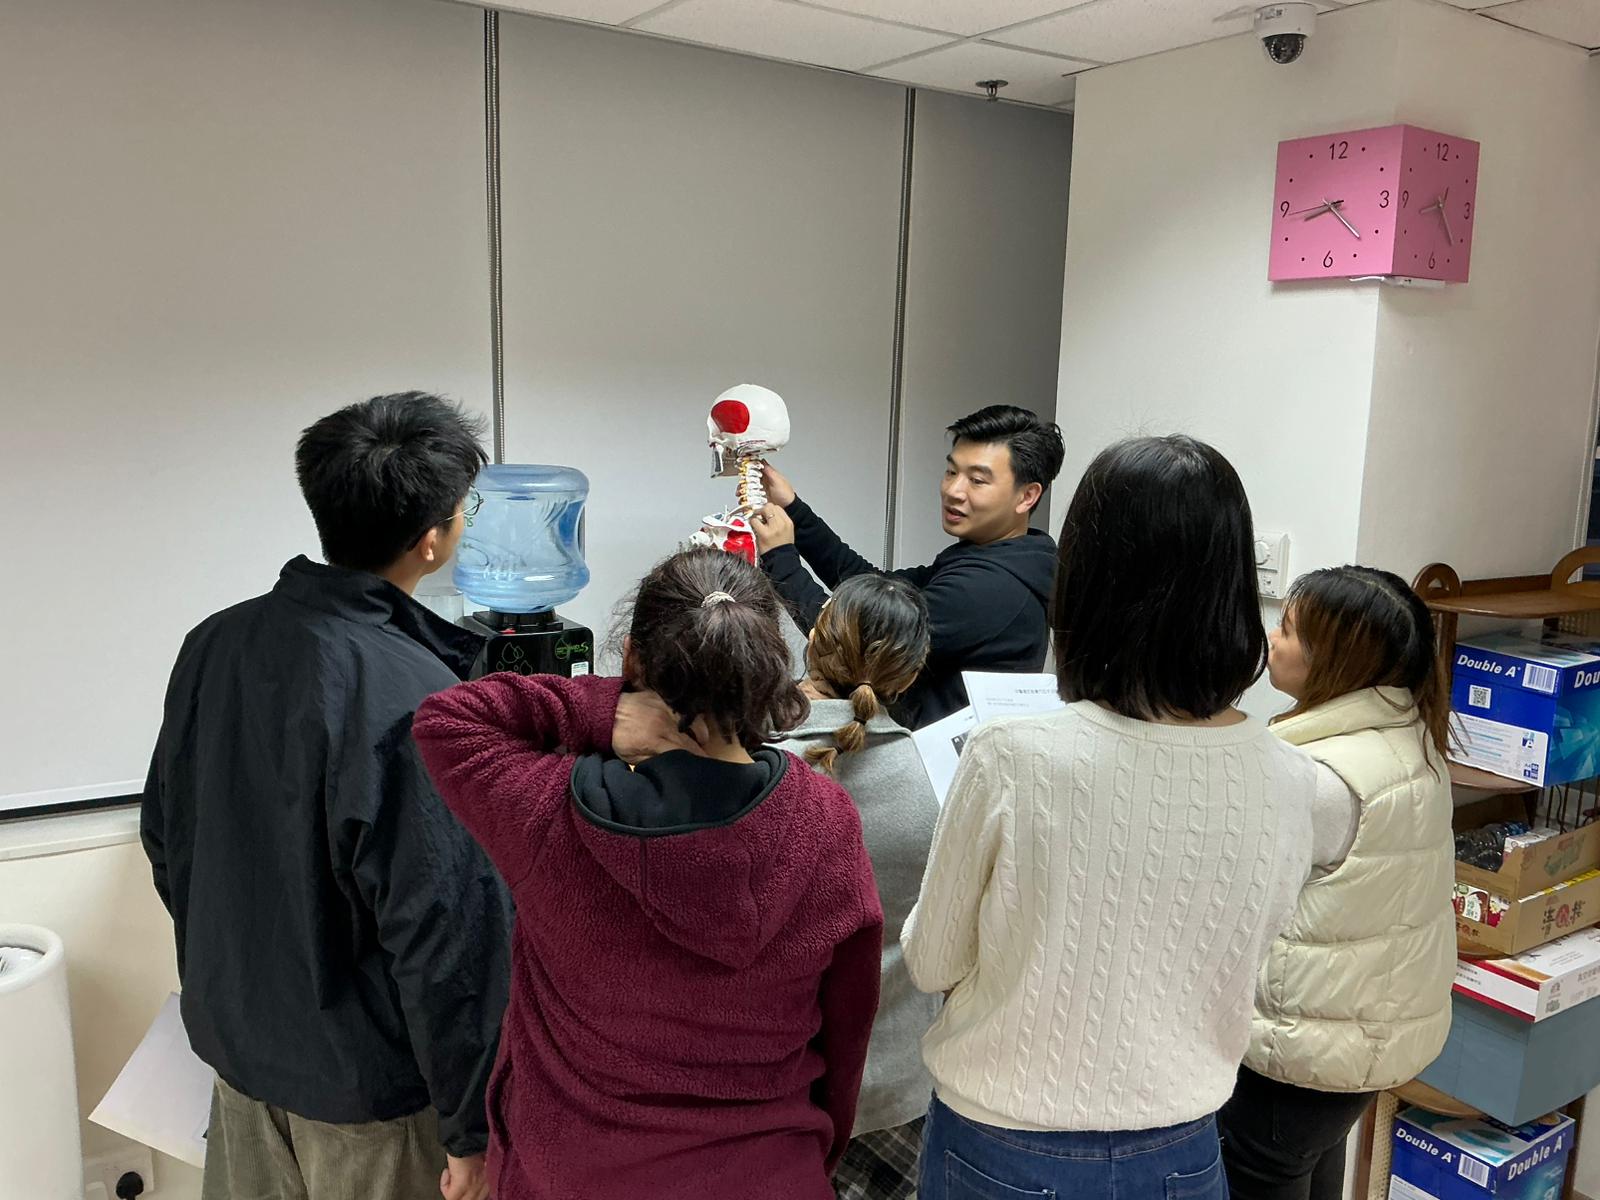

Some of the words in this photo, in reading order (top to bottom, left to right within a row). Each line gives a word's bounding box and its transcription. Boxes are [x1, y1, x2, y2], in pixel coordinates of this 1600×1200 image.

[1329, 140, 1349, 160] 12
[1436, 143, 1450, 162] 12
[1280, 200, 1290, 218] 9
[1379, 190, 1390, 209] 3
[1402, 190, 1410, 209] 9
[1463, 202, 1471, 220] 3
[1322, 250, 1334, 268] 6
[1428, 250, 1436, 269] 6
[1456, 654, 1503, 674] Double
[1504, 665, 1517, 678] A
[1395, 1127, 1439, 1156] Double
[1441, 1152, 1452, 1164] A
[1507, 1146, 1551, 1181] Double
[1553, 1135, 1562, 1153] A
